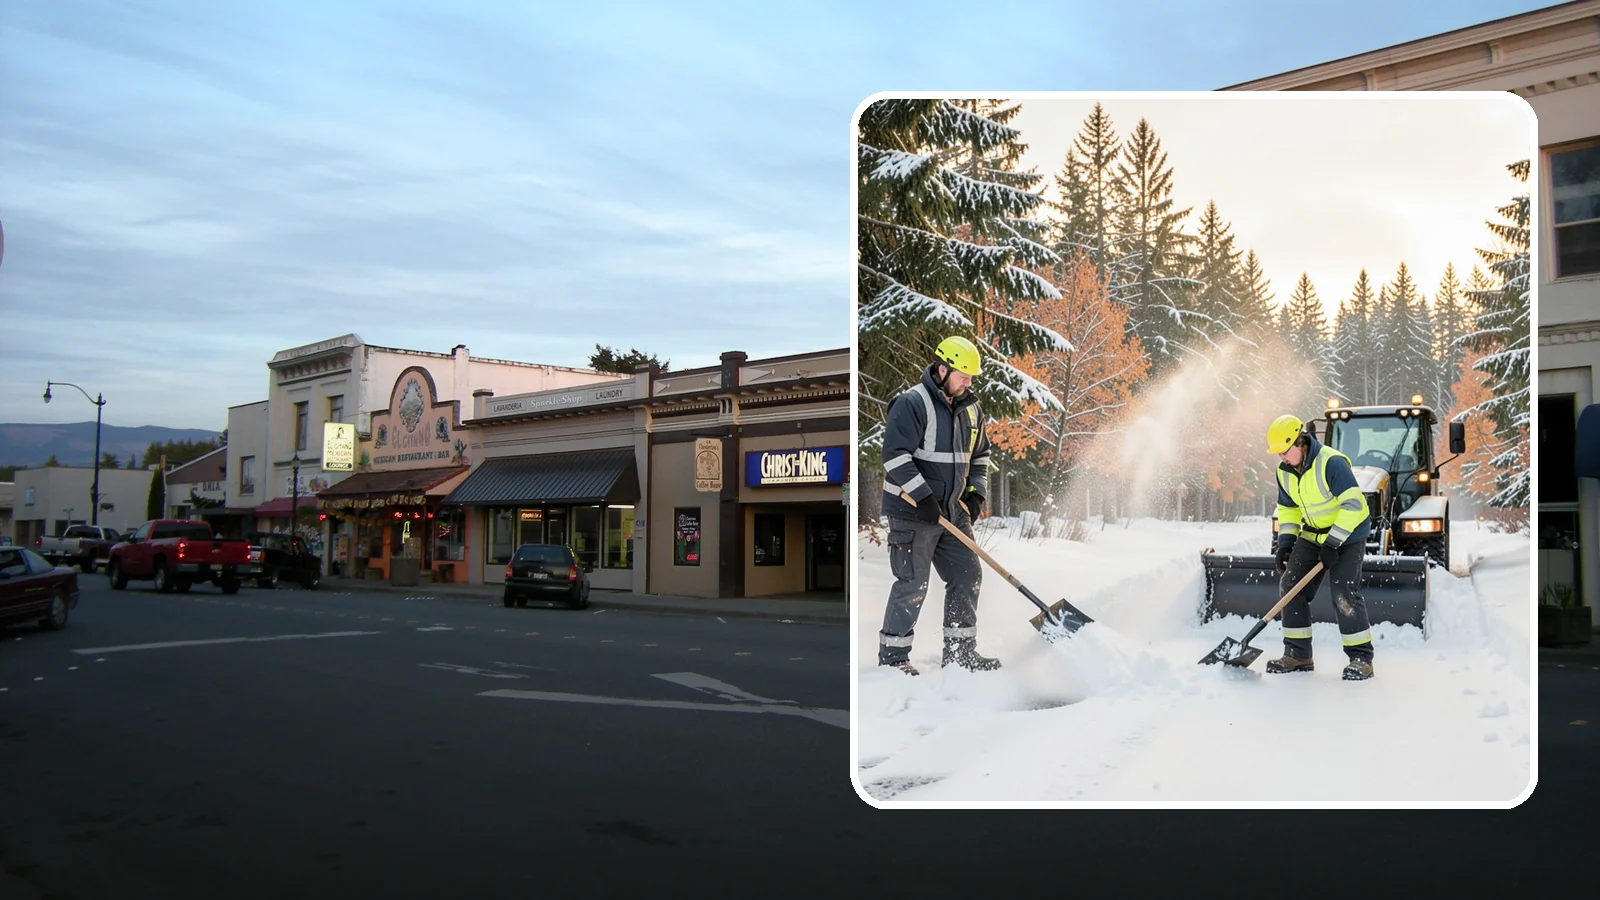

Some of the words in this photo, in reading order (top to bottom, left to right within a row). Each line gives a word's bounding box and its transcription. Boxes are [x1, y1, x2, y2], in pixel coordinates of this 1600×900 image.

[531, 399, 560, 409] Sparkle
[561, 394, 582, 406] Shop
[595, 389, 623, 400] LAUNDRY
[493, 402, 522, 413] LAVANDERIA
[374, 454, 396, 464] MEXICAN
[397, 451, 433, 462] RESTAURANT
[438, 450, 450, 459] BAR
[761, 452, 798, 478] CHRIST
[799, 450, 827, 476] KING
